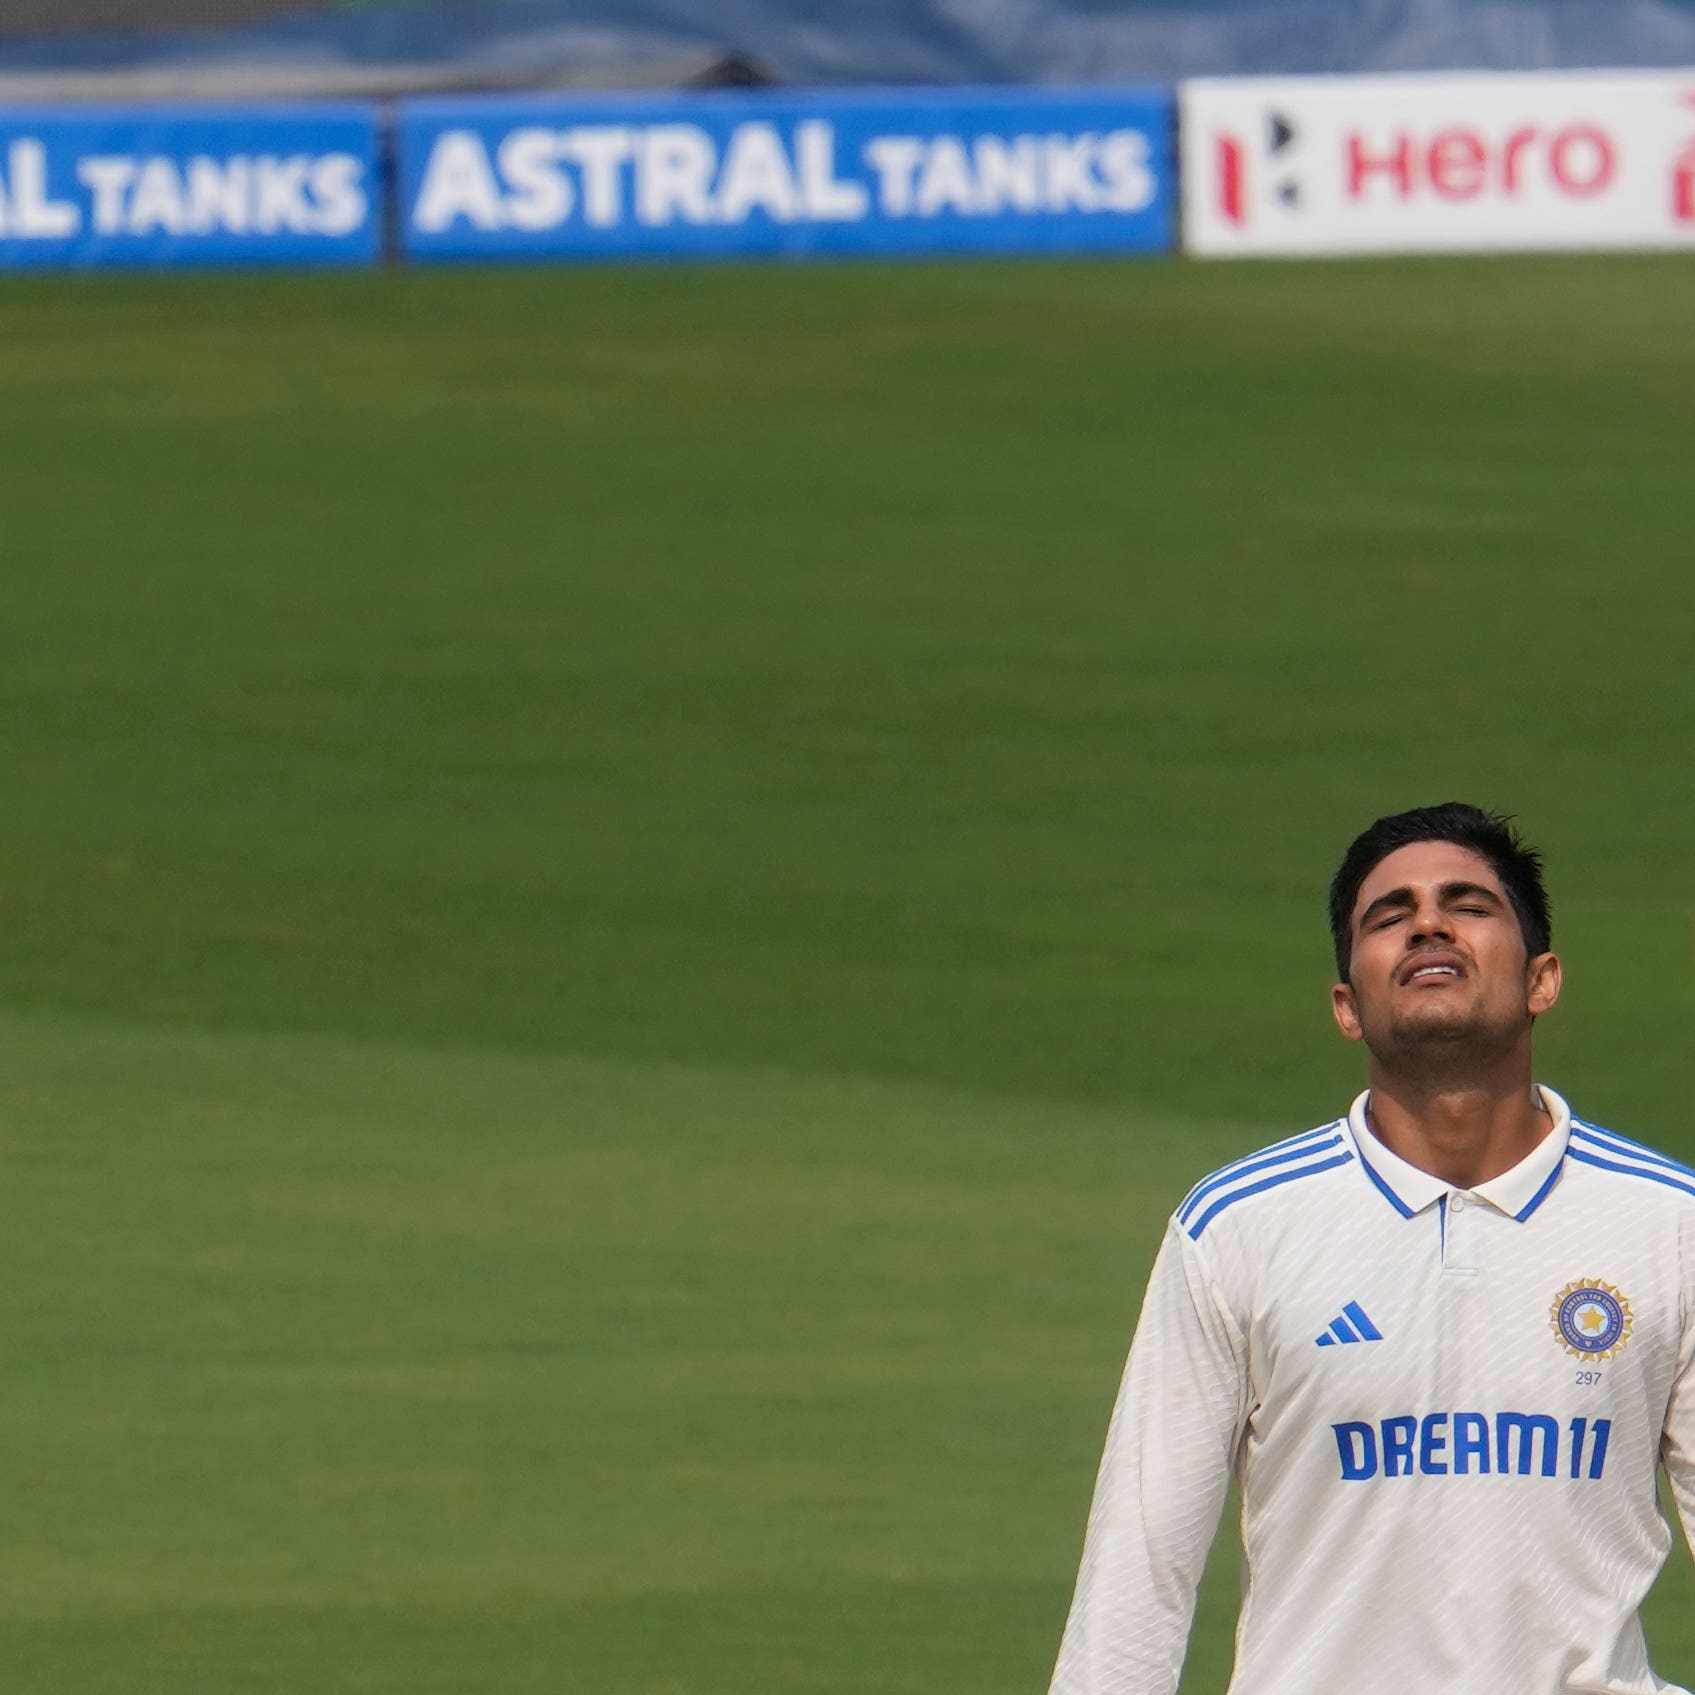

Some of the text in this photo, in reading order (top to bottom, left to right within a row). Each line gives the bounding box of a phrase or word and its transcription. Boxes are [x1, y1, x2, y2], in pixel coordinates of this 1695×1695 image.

[77, 154, 366, 237] TANKS
[413, 119, 1156, 233] ASTRAL TANKS
[1575, 1370, 1603, 1386] 297
